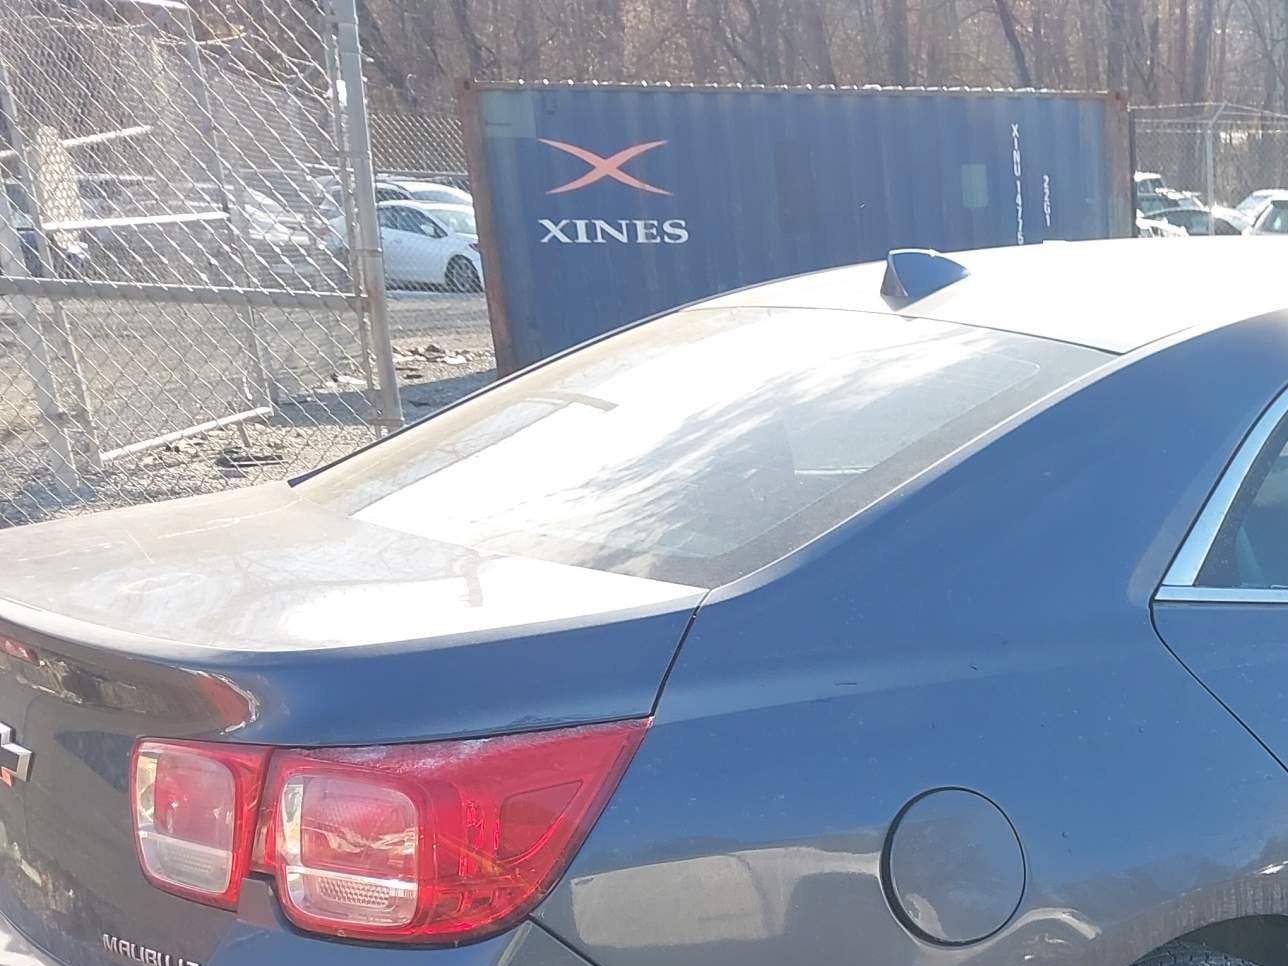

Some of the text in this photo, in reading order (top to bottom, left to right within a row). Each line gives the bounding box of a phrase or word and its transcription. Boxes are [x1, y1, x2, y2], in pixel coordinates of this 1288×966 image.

[1011, 123, 1021, 177] XINU
[1043, 174, 1051, 228] 22G1
[538, 218, 689, 244] XINES
